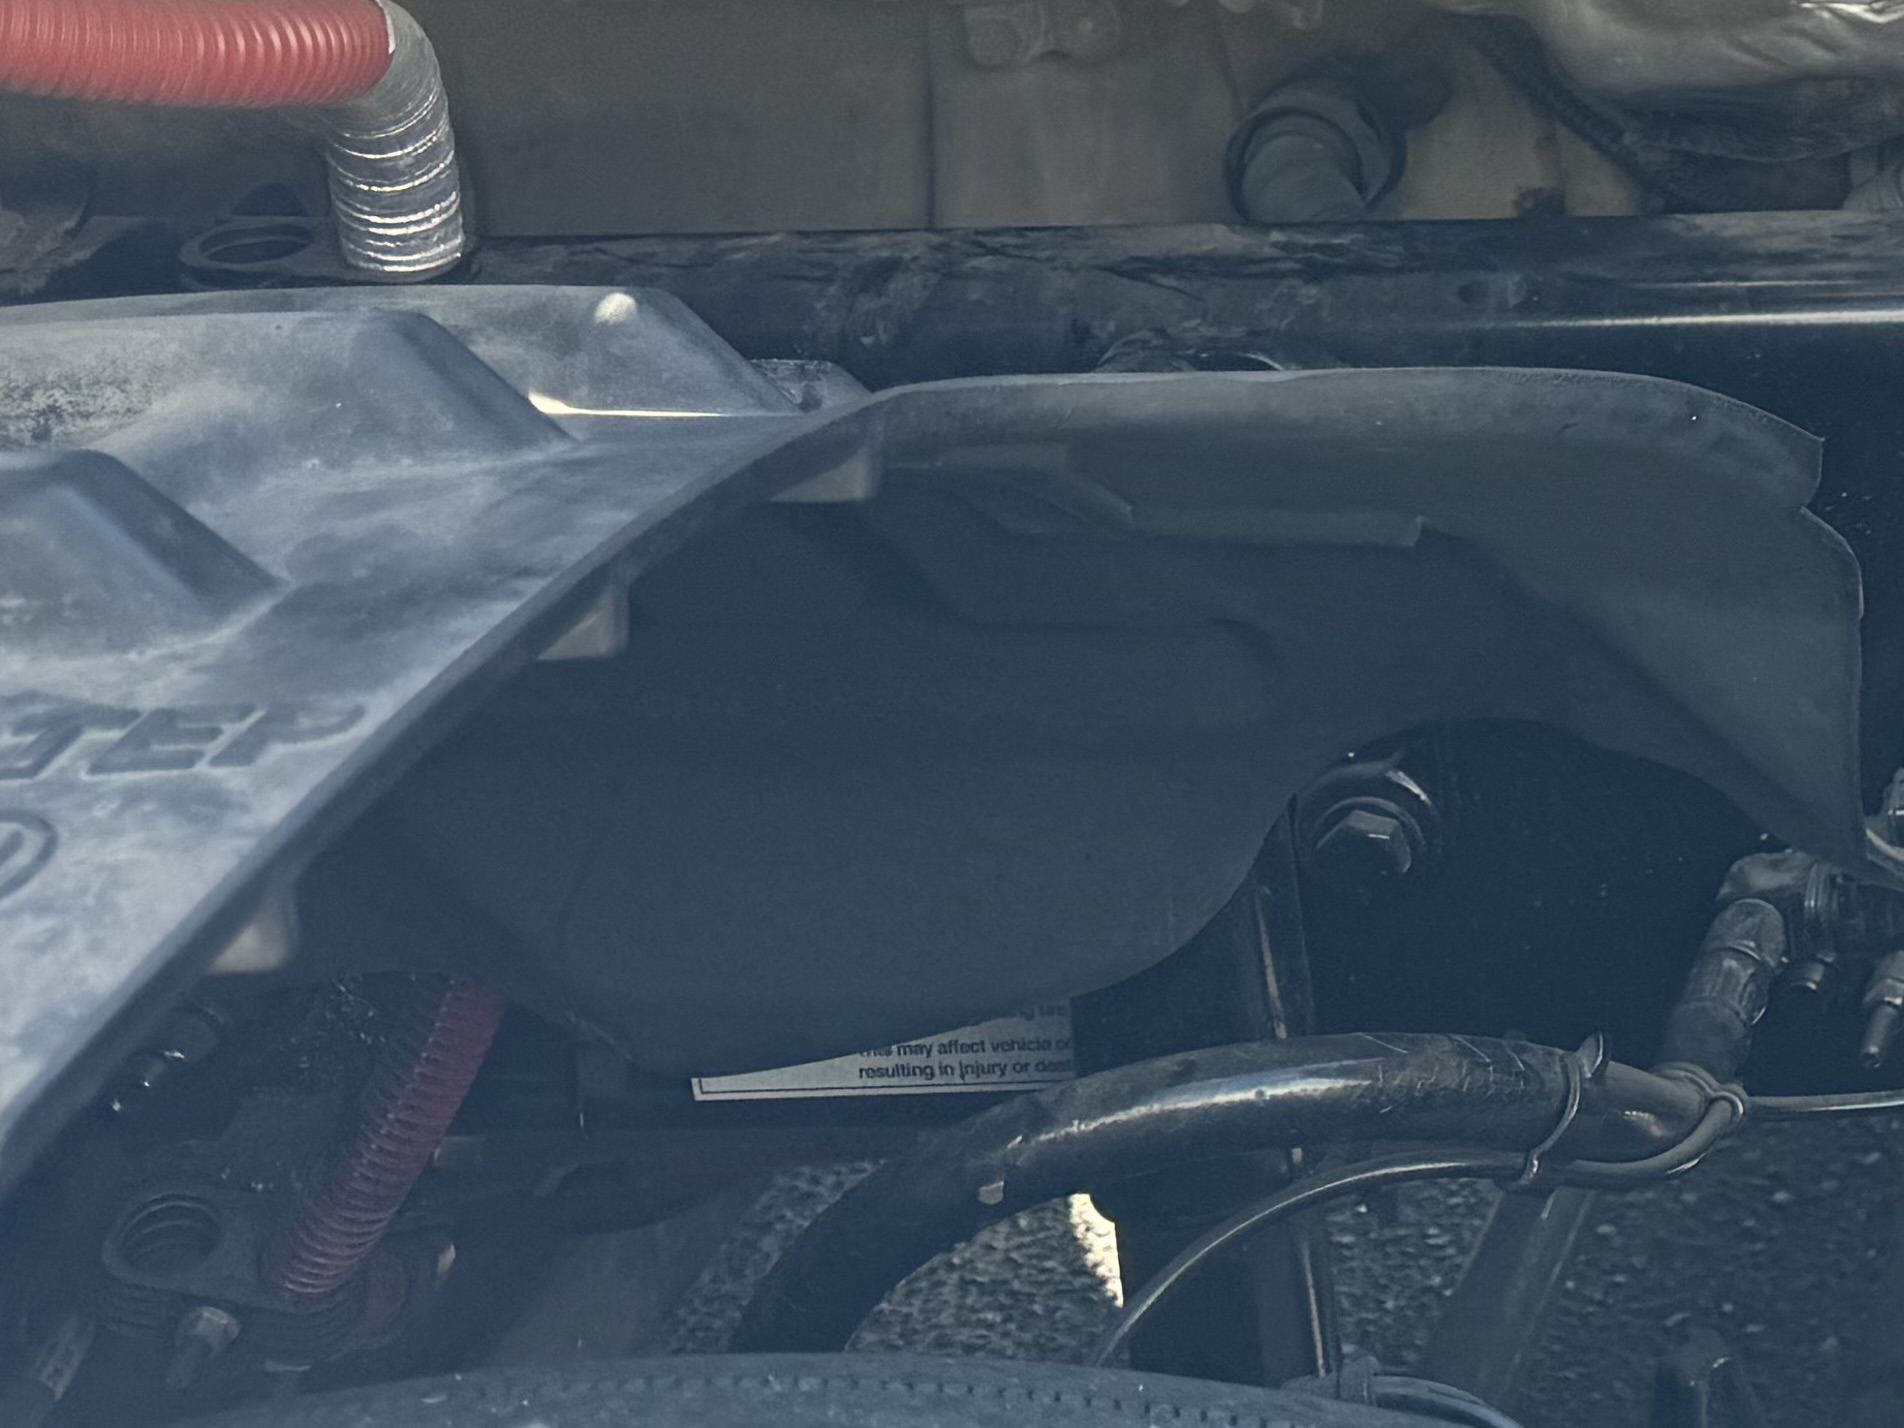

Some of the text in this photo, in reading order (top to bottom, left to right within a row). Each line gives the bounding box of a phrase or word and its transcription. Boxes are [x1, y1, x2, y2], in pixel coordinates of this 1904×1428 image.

[896, 1042, 932, 1059] may
[937, 1040, 987, 1055] affect
[991, 1038, 1051, 1055] vehicle
[858, 1061, 935, 1080] resulting
[939, 1061, 954, 1078] in
[1013, 1061, 1032, 1075] or
